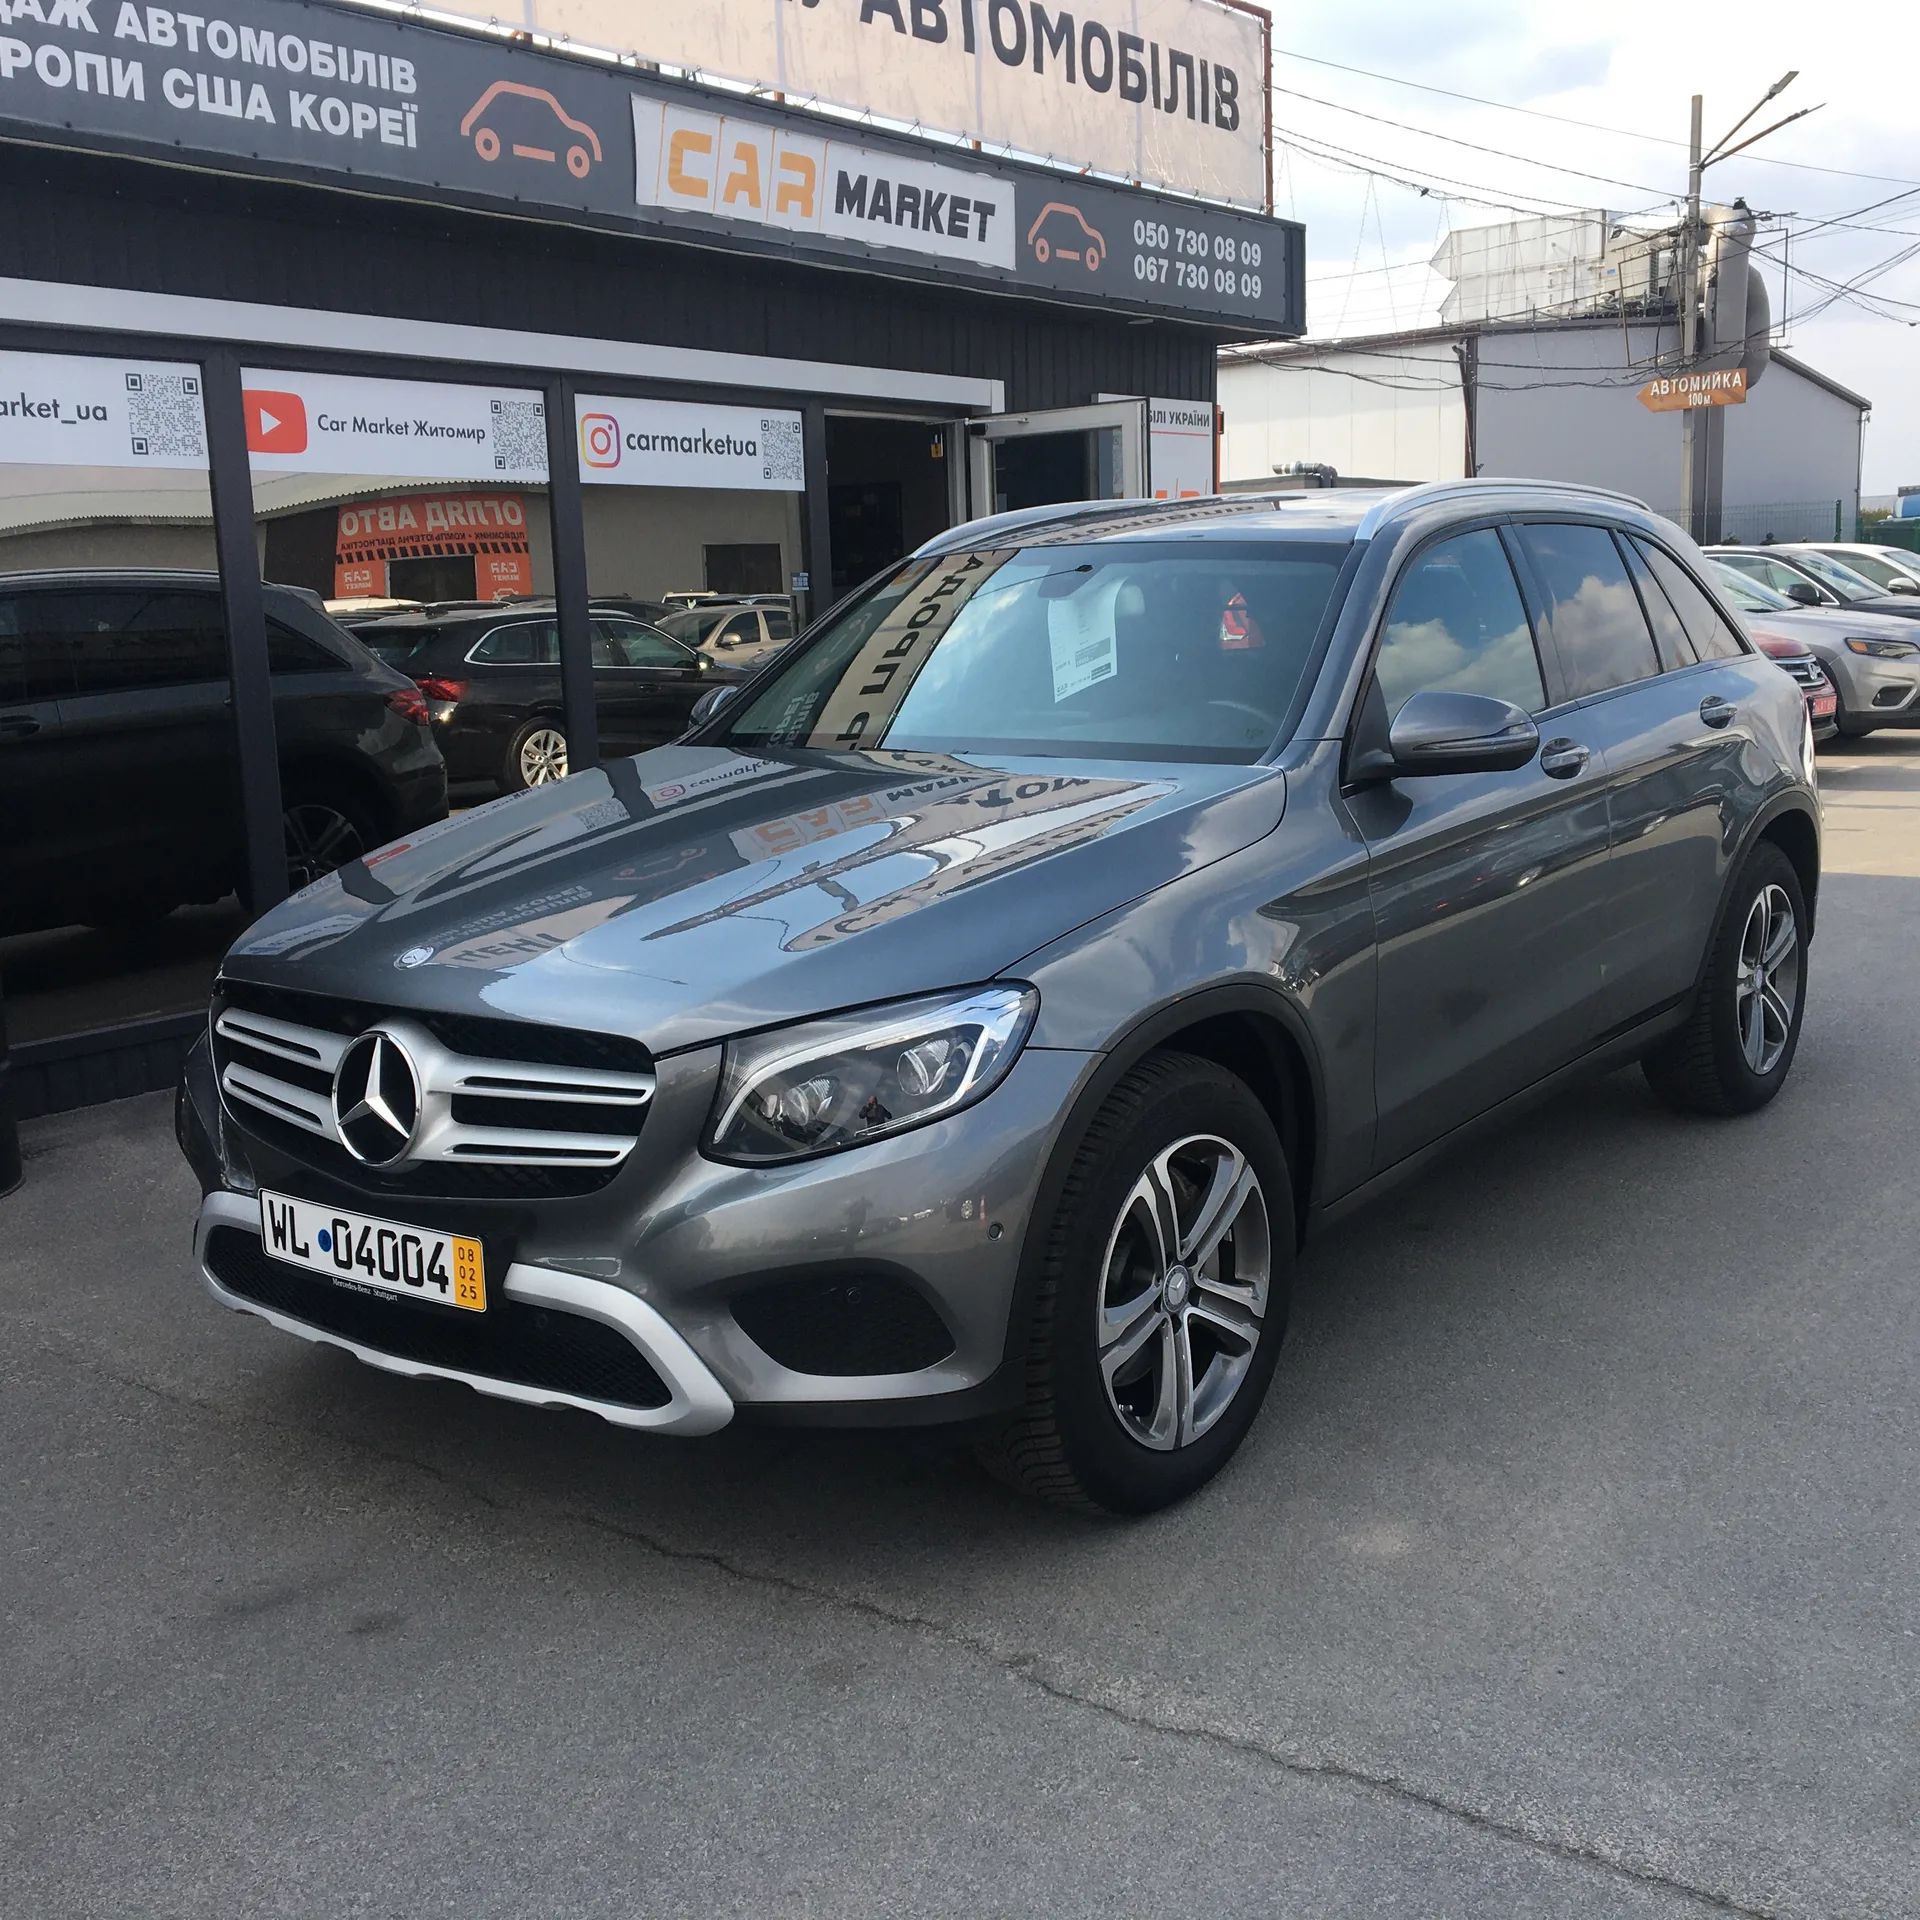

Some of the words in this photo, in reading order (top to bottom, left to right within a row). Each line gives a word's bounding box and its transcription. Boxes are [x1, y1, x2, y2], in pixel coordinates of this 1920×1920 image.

[0, 0, 99, 33] АЖ
[114, 1, 417, 94] АВТОМОБІЛІВ
[162, 68, 276, 124] США
[289, 90, 418, 148] КОРЕЇ
[668, 129, 816, 219] CAR
[835, 169, 996, 242] MARKET
[1133, 219, 1169, 250] 050
[1175, 227, 1209, 257] 730
[1214, 235, 1236, 262] 08
[1240, 240, 1262, 267] 09
[1133, 254, 1169, 284] 067
[1175, 261, 1209, 290] 730
[1214, 268, 1236, 294] 08
[1240, 273, 1262, 299] 09
[1650, 371, 1743, 396] АВТОМИЙКА
[317, 414, 347, 432] Car
[352, 416, 409, 436] Market
[413, 420, 486, 444] Житомир
[1169, 410, 1210, 427] УКРАЇНИ
[626, 427, 757, 457] carmarketua
[268, 1199, 310, 1260] WL
[331, 1218, 450, 1294] 04004
[457, 1246, 476, 1263] 08
[332, 1277, 372, 1295] Mercedes-Benz
[459, 1266, 477, 1282] 02
[460, 1283, 478, 1300] 25
